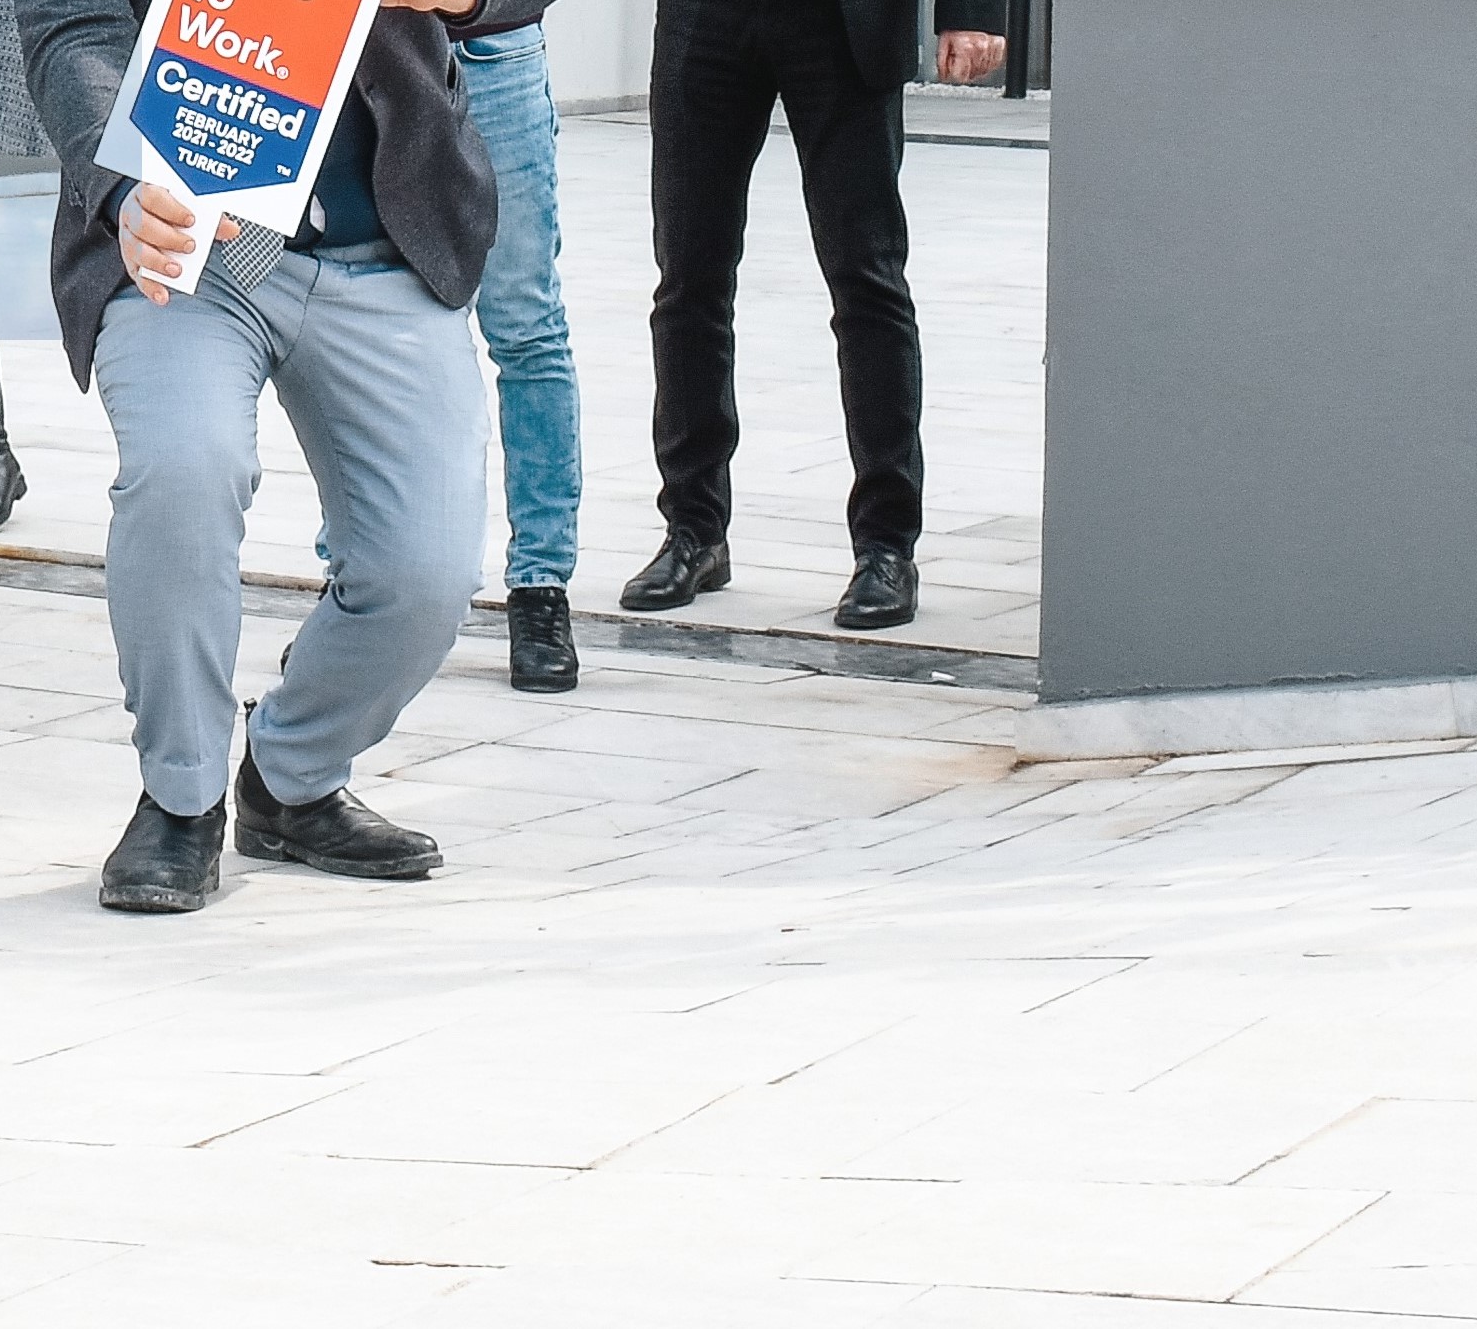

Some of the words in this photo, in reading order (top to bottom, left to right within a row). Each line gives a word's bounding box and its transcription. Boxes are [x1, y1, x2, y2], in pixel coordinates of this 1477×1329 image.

[156, 61, 306, 141] Certified
[172, 122, 209, 152] 2021
[218, 139, 256, 166] 2022
[175, 106, 263, 147] FEBRUARY
[177, 145, 239, 183] TURKEY
